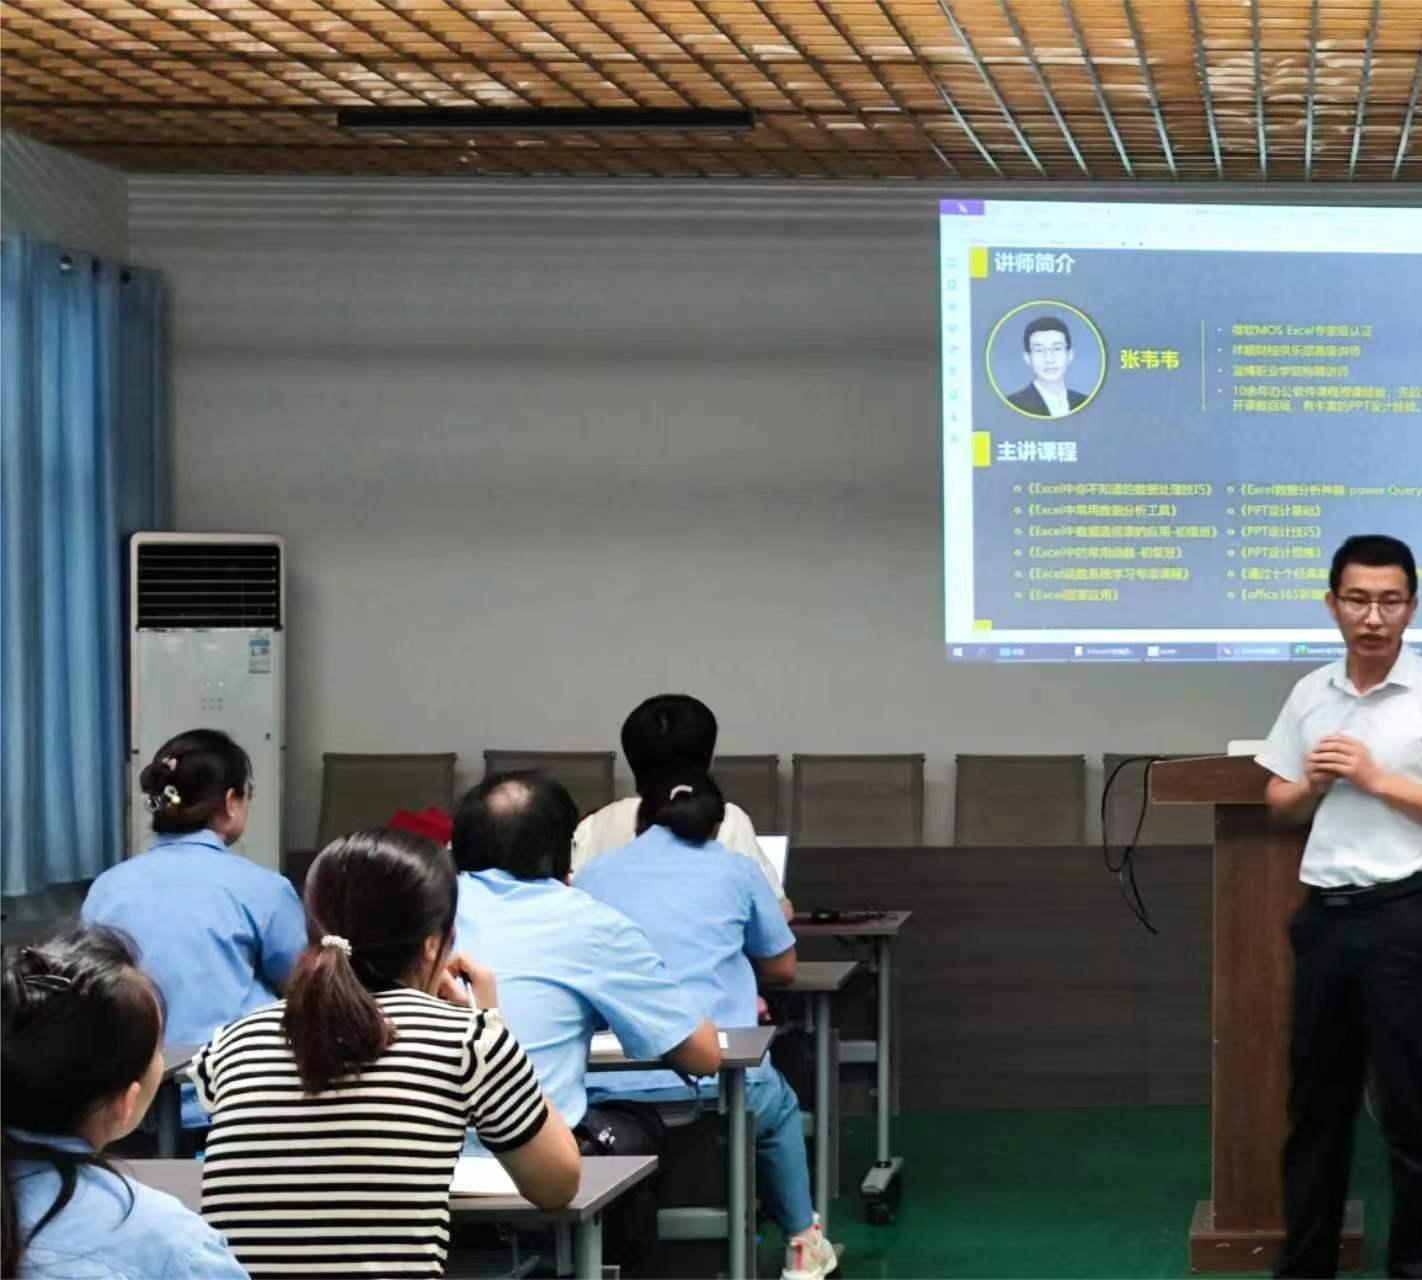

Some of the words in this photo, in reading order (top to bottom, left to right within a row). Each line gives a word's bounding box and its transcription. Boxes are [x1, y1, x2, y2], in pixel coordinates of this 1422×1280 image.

[994, 252, 1076, 275] 讲师简介
[1120, 348, 1181, 371] 张韦韦
[996, 440, 1079, 463] 主讲课程
